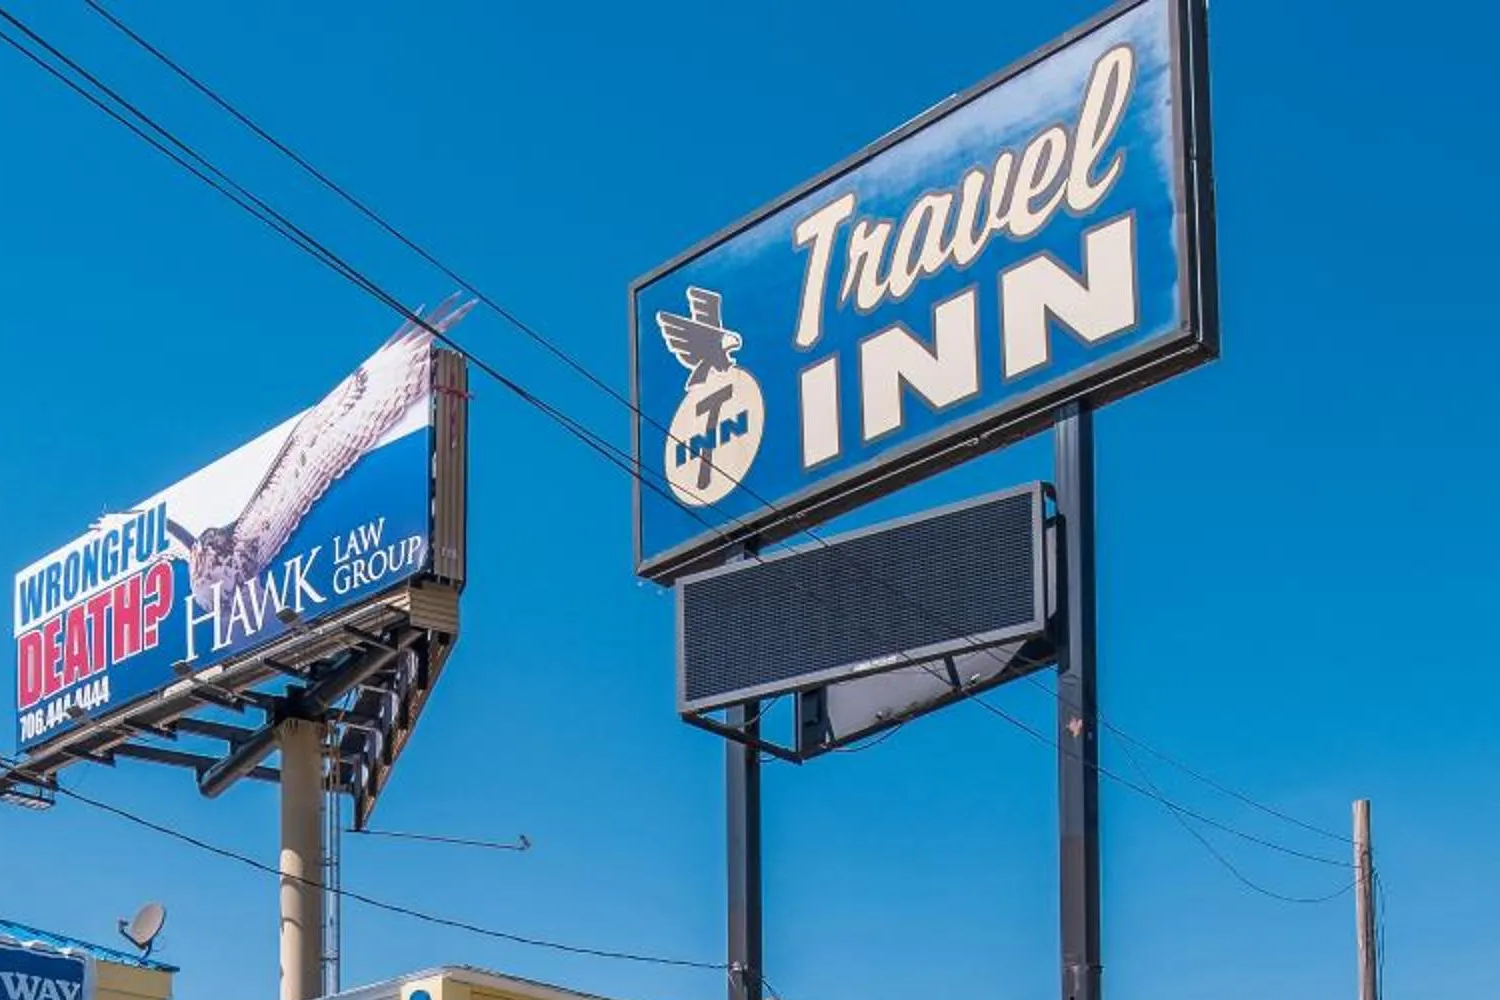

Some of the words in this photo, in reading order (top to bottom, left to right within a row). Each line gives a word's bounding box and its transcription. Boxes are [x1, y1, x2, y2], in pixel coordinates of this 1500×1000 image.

[795, 43, 1135, 347] Travel
[801, 214, 1137, 469] INN
[675, 409, 749, 468] INN
[19, 501, 171, 627] WRONGFUL
[332, 517, 386, 565] LAW
[332, 535, 422, 595] GROUP
[17, 558, 175, 712] DEATH?
[174, 545, 327, 664] HAWK
[19, 675, 110, 743] 706.4444444
